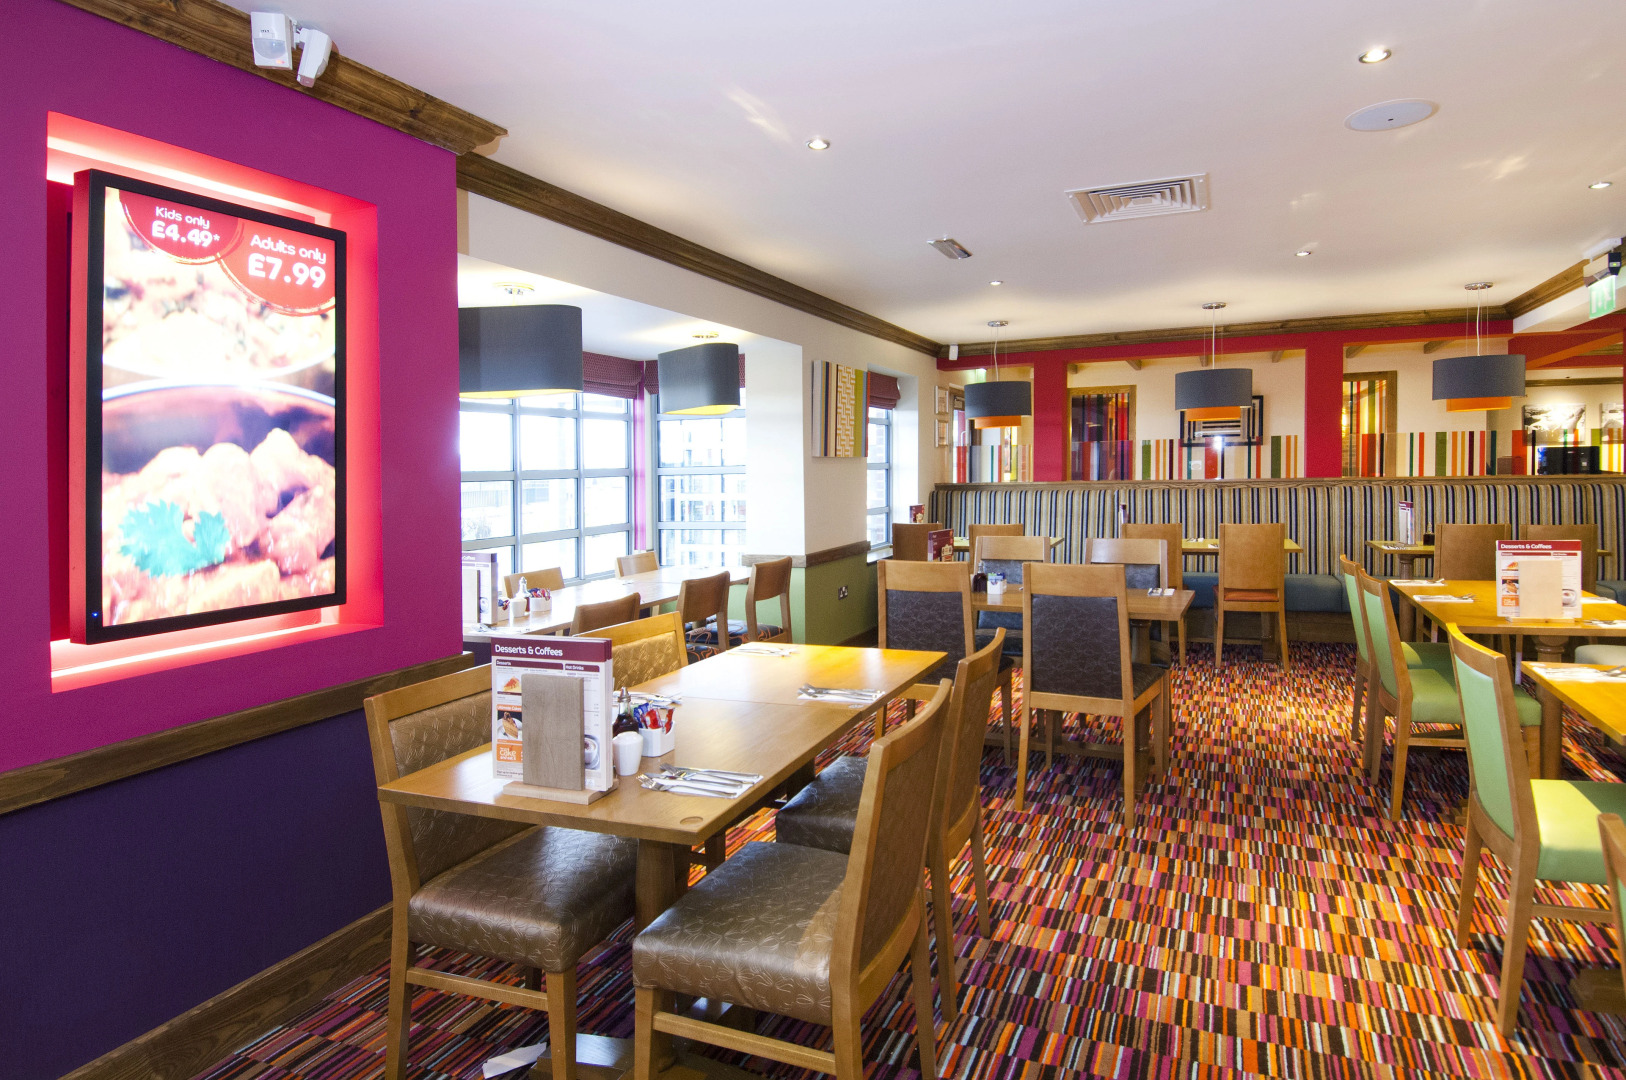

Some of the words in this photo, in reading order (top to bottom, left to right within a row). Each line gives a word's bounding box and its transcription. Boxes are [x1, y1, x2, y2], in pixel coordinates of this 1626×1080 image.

[155, 206, 183, 222] Kids
[185, 214, 210, 230] only
[250, 234, 296, 256] Adults
[298, 245, 326, 264] only
[495, 644, 526, 655] Desserts
[527, 646, 534, 656] &
[534, 646, 563, 656] Coffees
